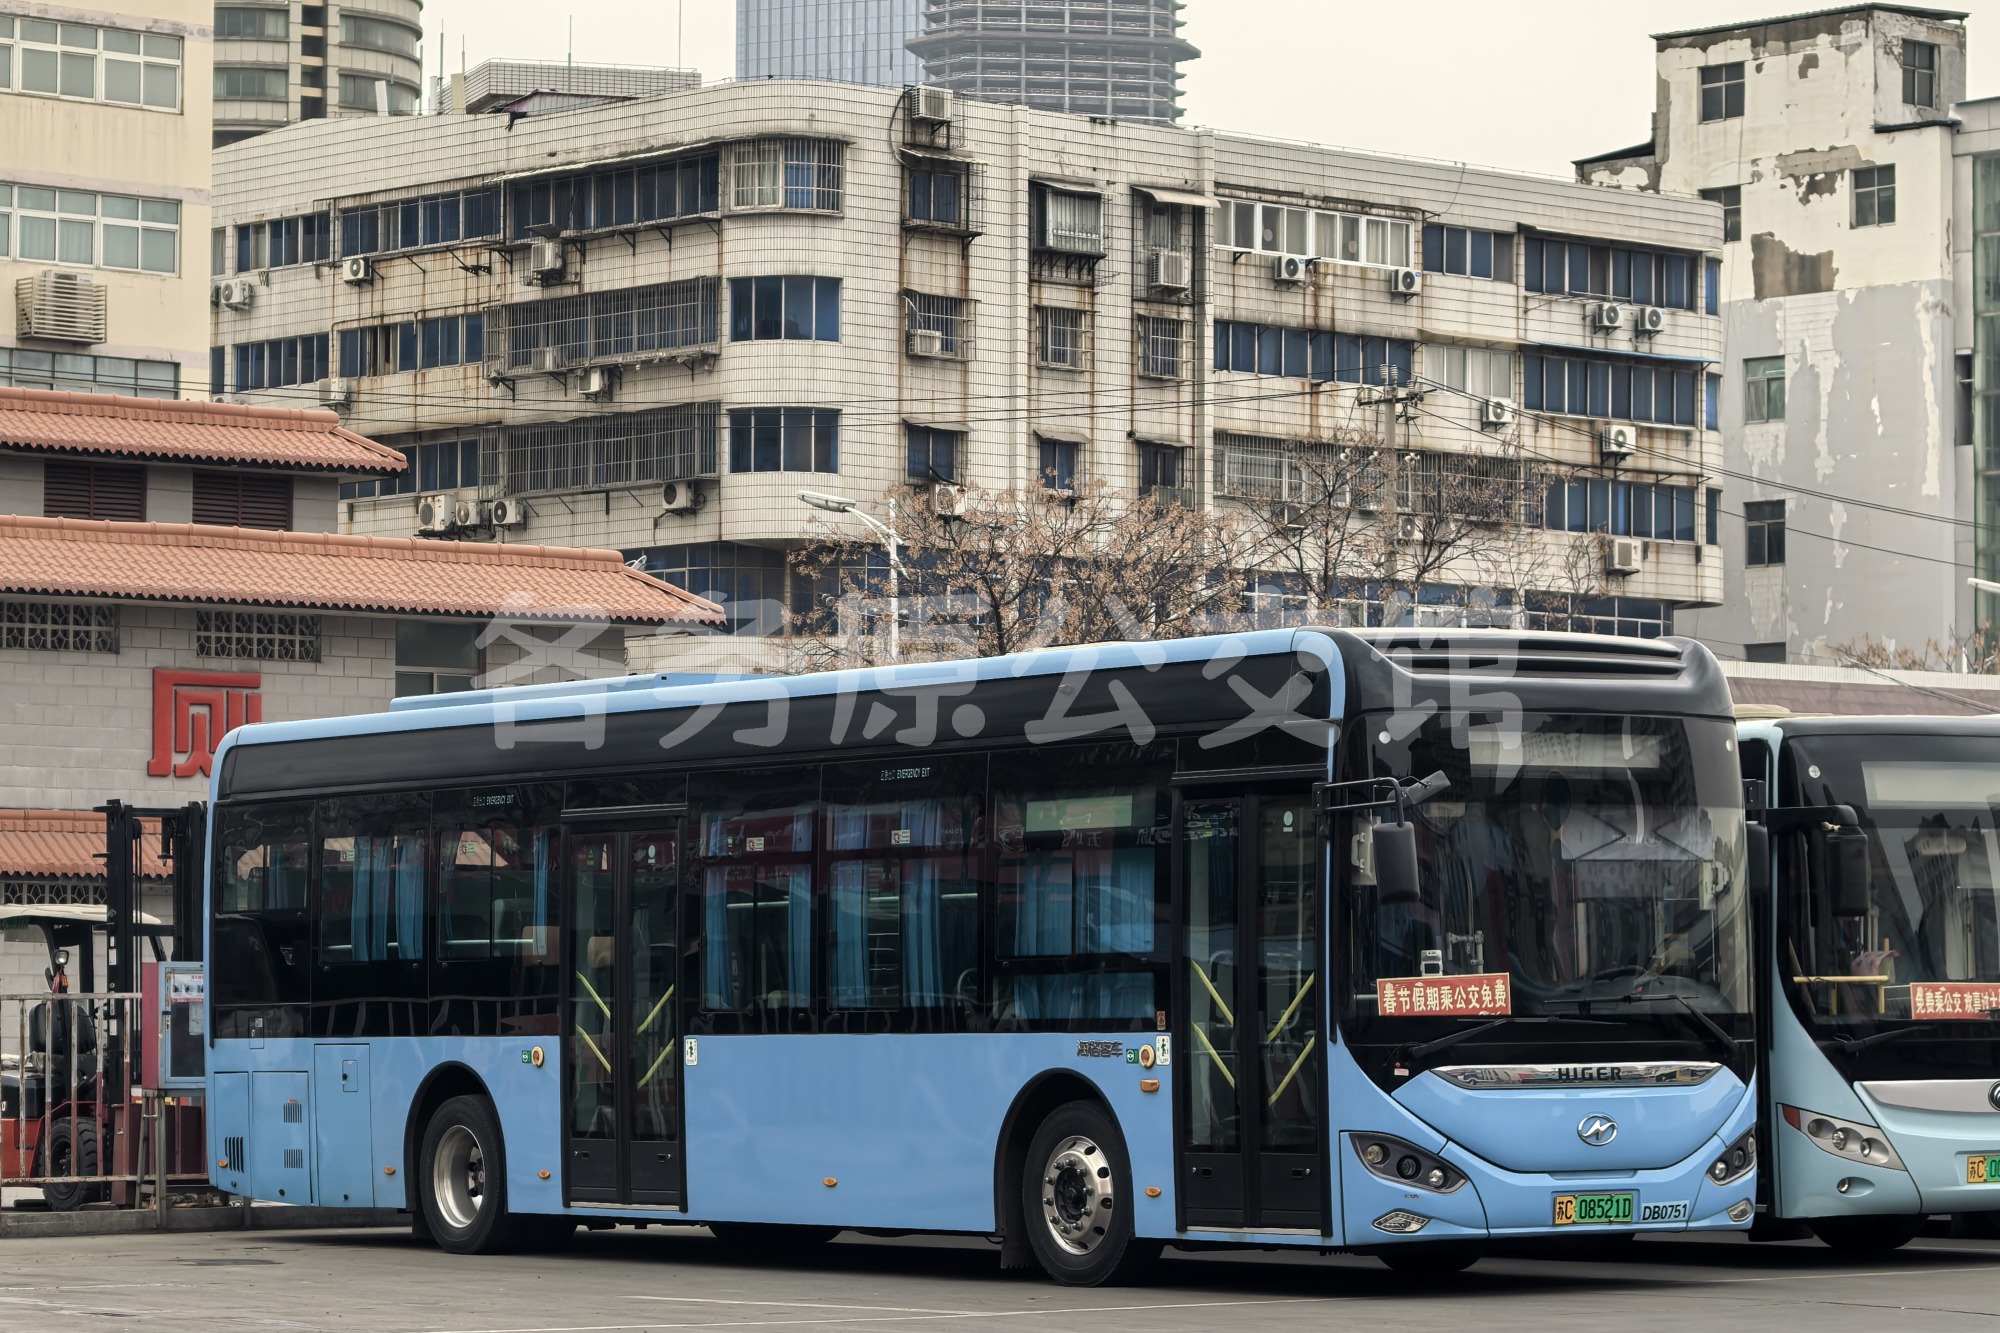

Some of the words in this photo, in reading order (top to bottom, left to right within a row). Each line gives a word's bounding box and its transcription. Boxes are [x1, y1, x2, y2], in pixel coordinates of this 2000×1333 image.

[147, 667, 261, 777] 厕
[1383, 980, 1507, 1014] 春节假期乘公交免费
[1915, 987, 1963, 1014] 免费乘公交
[1558, 1066, 1622, 1081] HIGER
[1969, 1159, 2000, 1179] 苏C0
[1642, 1203, 1688, 1221] DB0751
